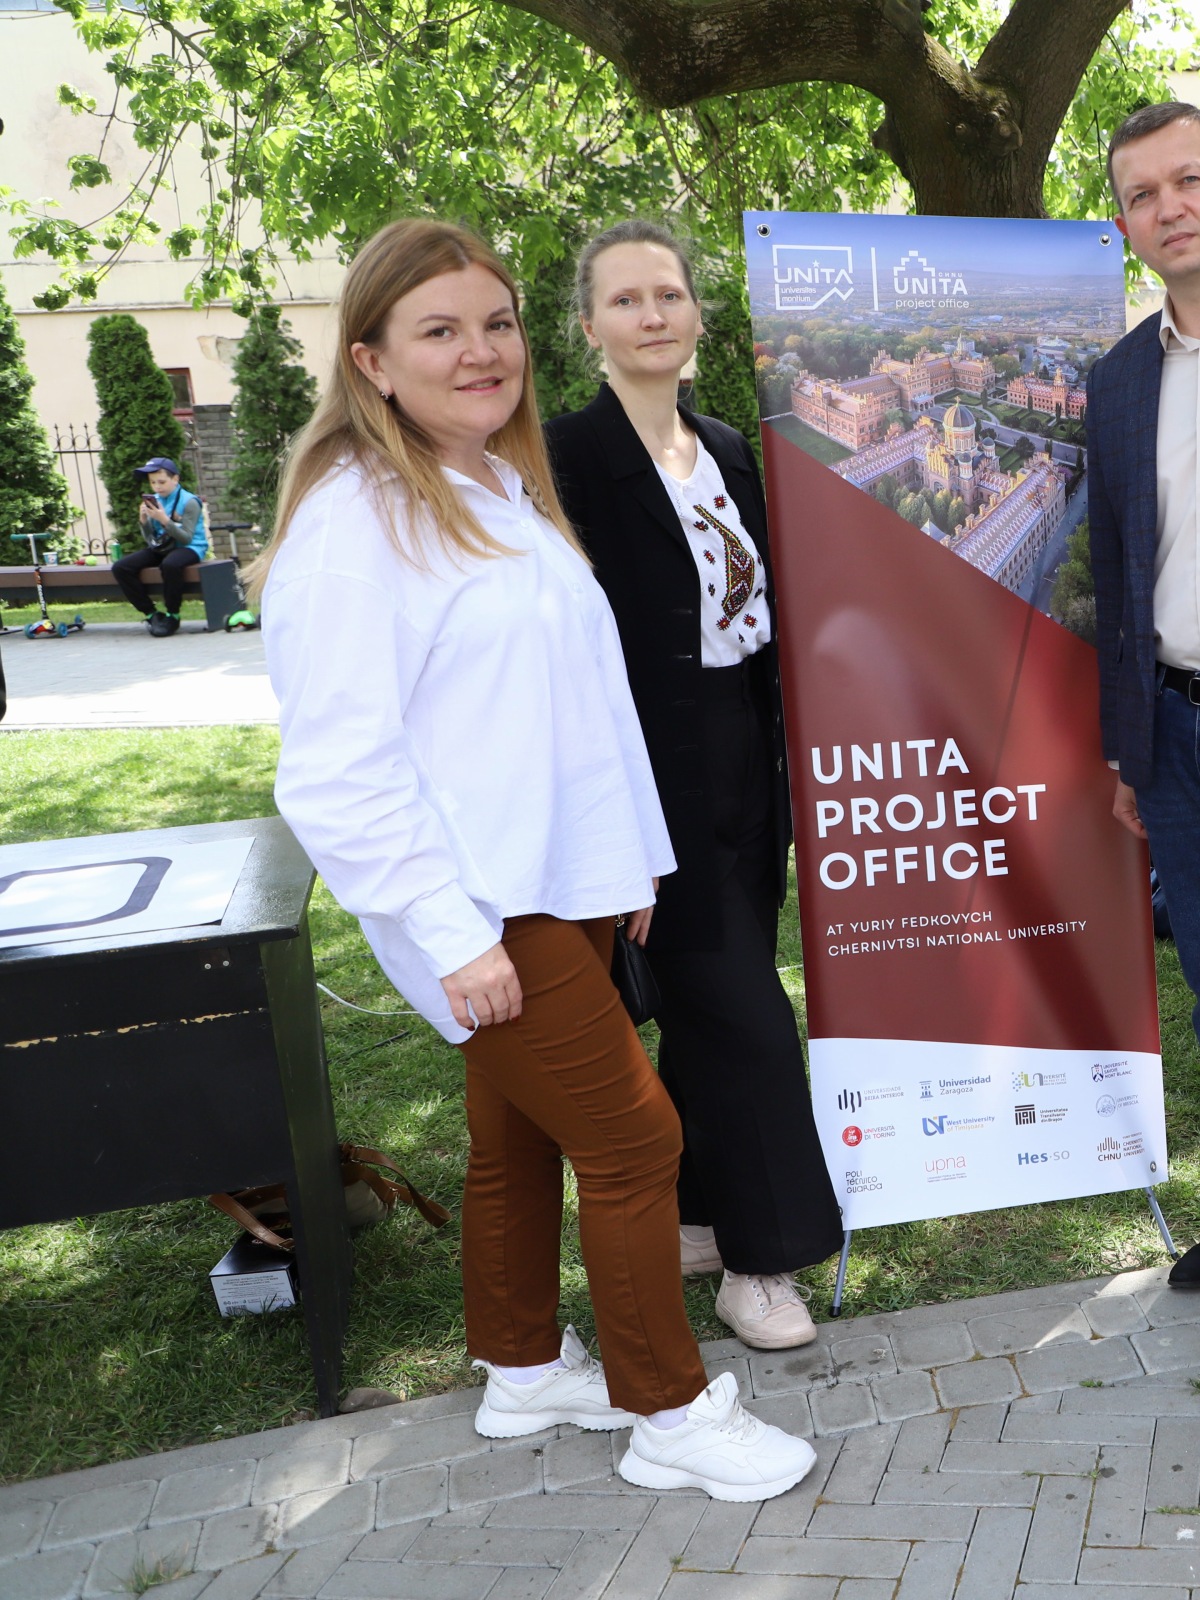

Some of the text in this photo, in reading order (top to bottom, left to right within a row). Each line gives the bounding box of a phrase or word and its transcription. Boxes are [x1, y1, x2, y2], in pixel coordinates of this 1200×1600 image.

[773, 267, 854, 285] UNITA
[781, 286, 817, 294] universitas
[893, 277, 969, 295] UNITA
[895, 298, 970, 310] project office
[811, 737, 970, 785] UNITA
[815, 783, 1046, 839] PROJECT
[819, 838, 1009, 891] OFFICE
[826, 910, 992, 936] AT YURIY FEDKOVYCH
[828, 920, 1087, 957] CHERNIVTSI NATIONAL UNIVERSITY
[938, 1074, 991, 1088] Universidad
[940, 1086, 974, 1096] Zaragoza
[963, 1115, 995, 1125] University
[872, 1131, 896, 1139] TORINO
[925, 1155, 967, 1175] upna
[1097, 1152, 1122, 1162] CHNU
[845, 1170, 863, 1179] POLI
